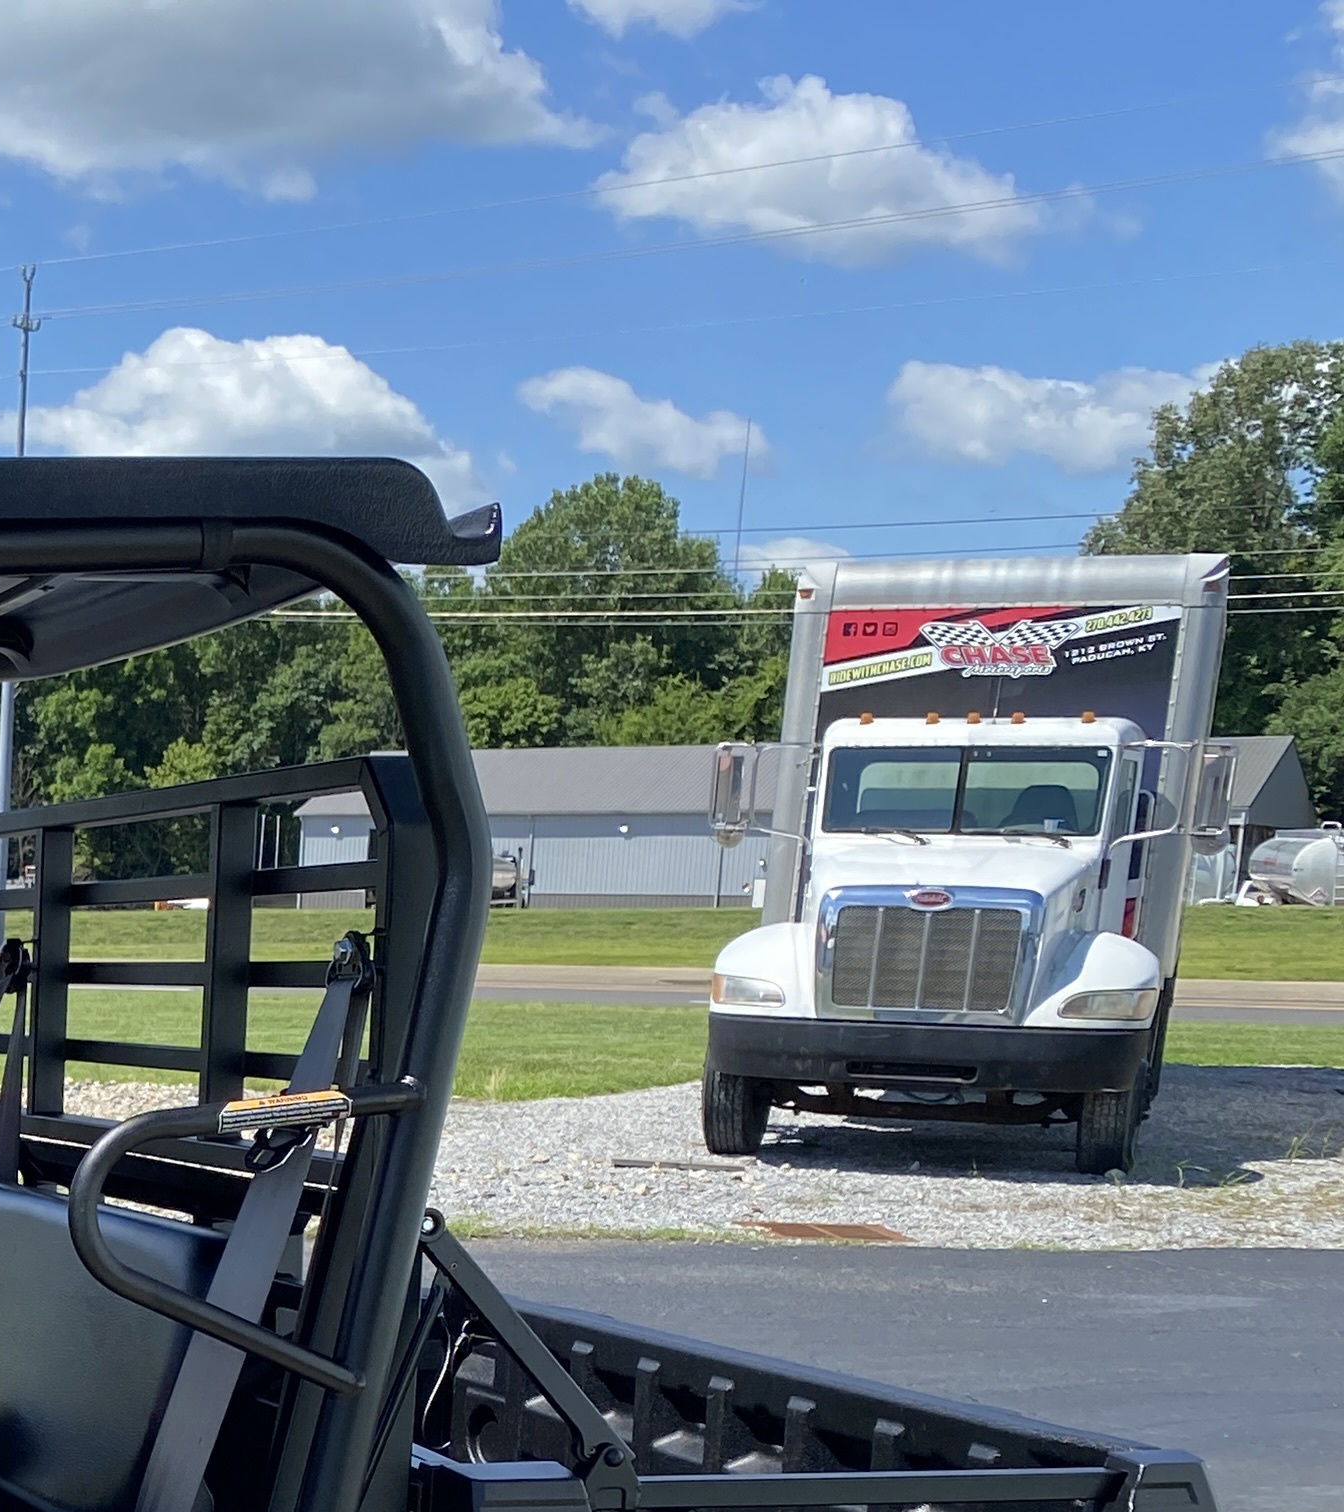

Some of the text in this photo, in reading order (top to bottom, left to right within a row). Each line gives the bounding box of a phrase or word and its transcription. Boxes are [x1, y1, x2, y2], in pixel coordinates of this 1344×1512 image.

[1084, 606, 1154, 633] 270.442.4273
[1071, 643, 1155, 665] PADUCAH, KY
[1099, 637, 1144, 651] BROWN
[941, 645, 1053, 666] CHASE
[828, 652, 932, 686] RIDEWITHCHASE.COM
